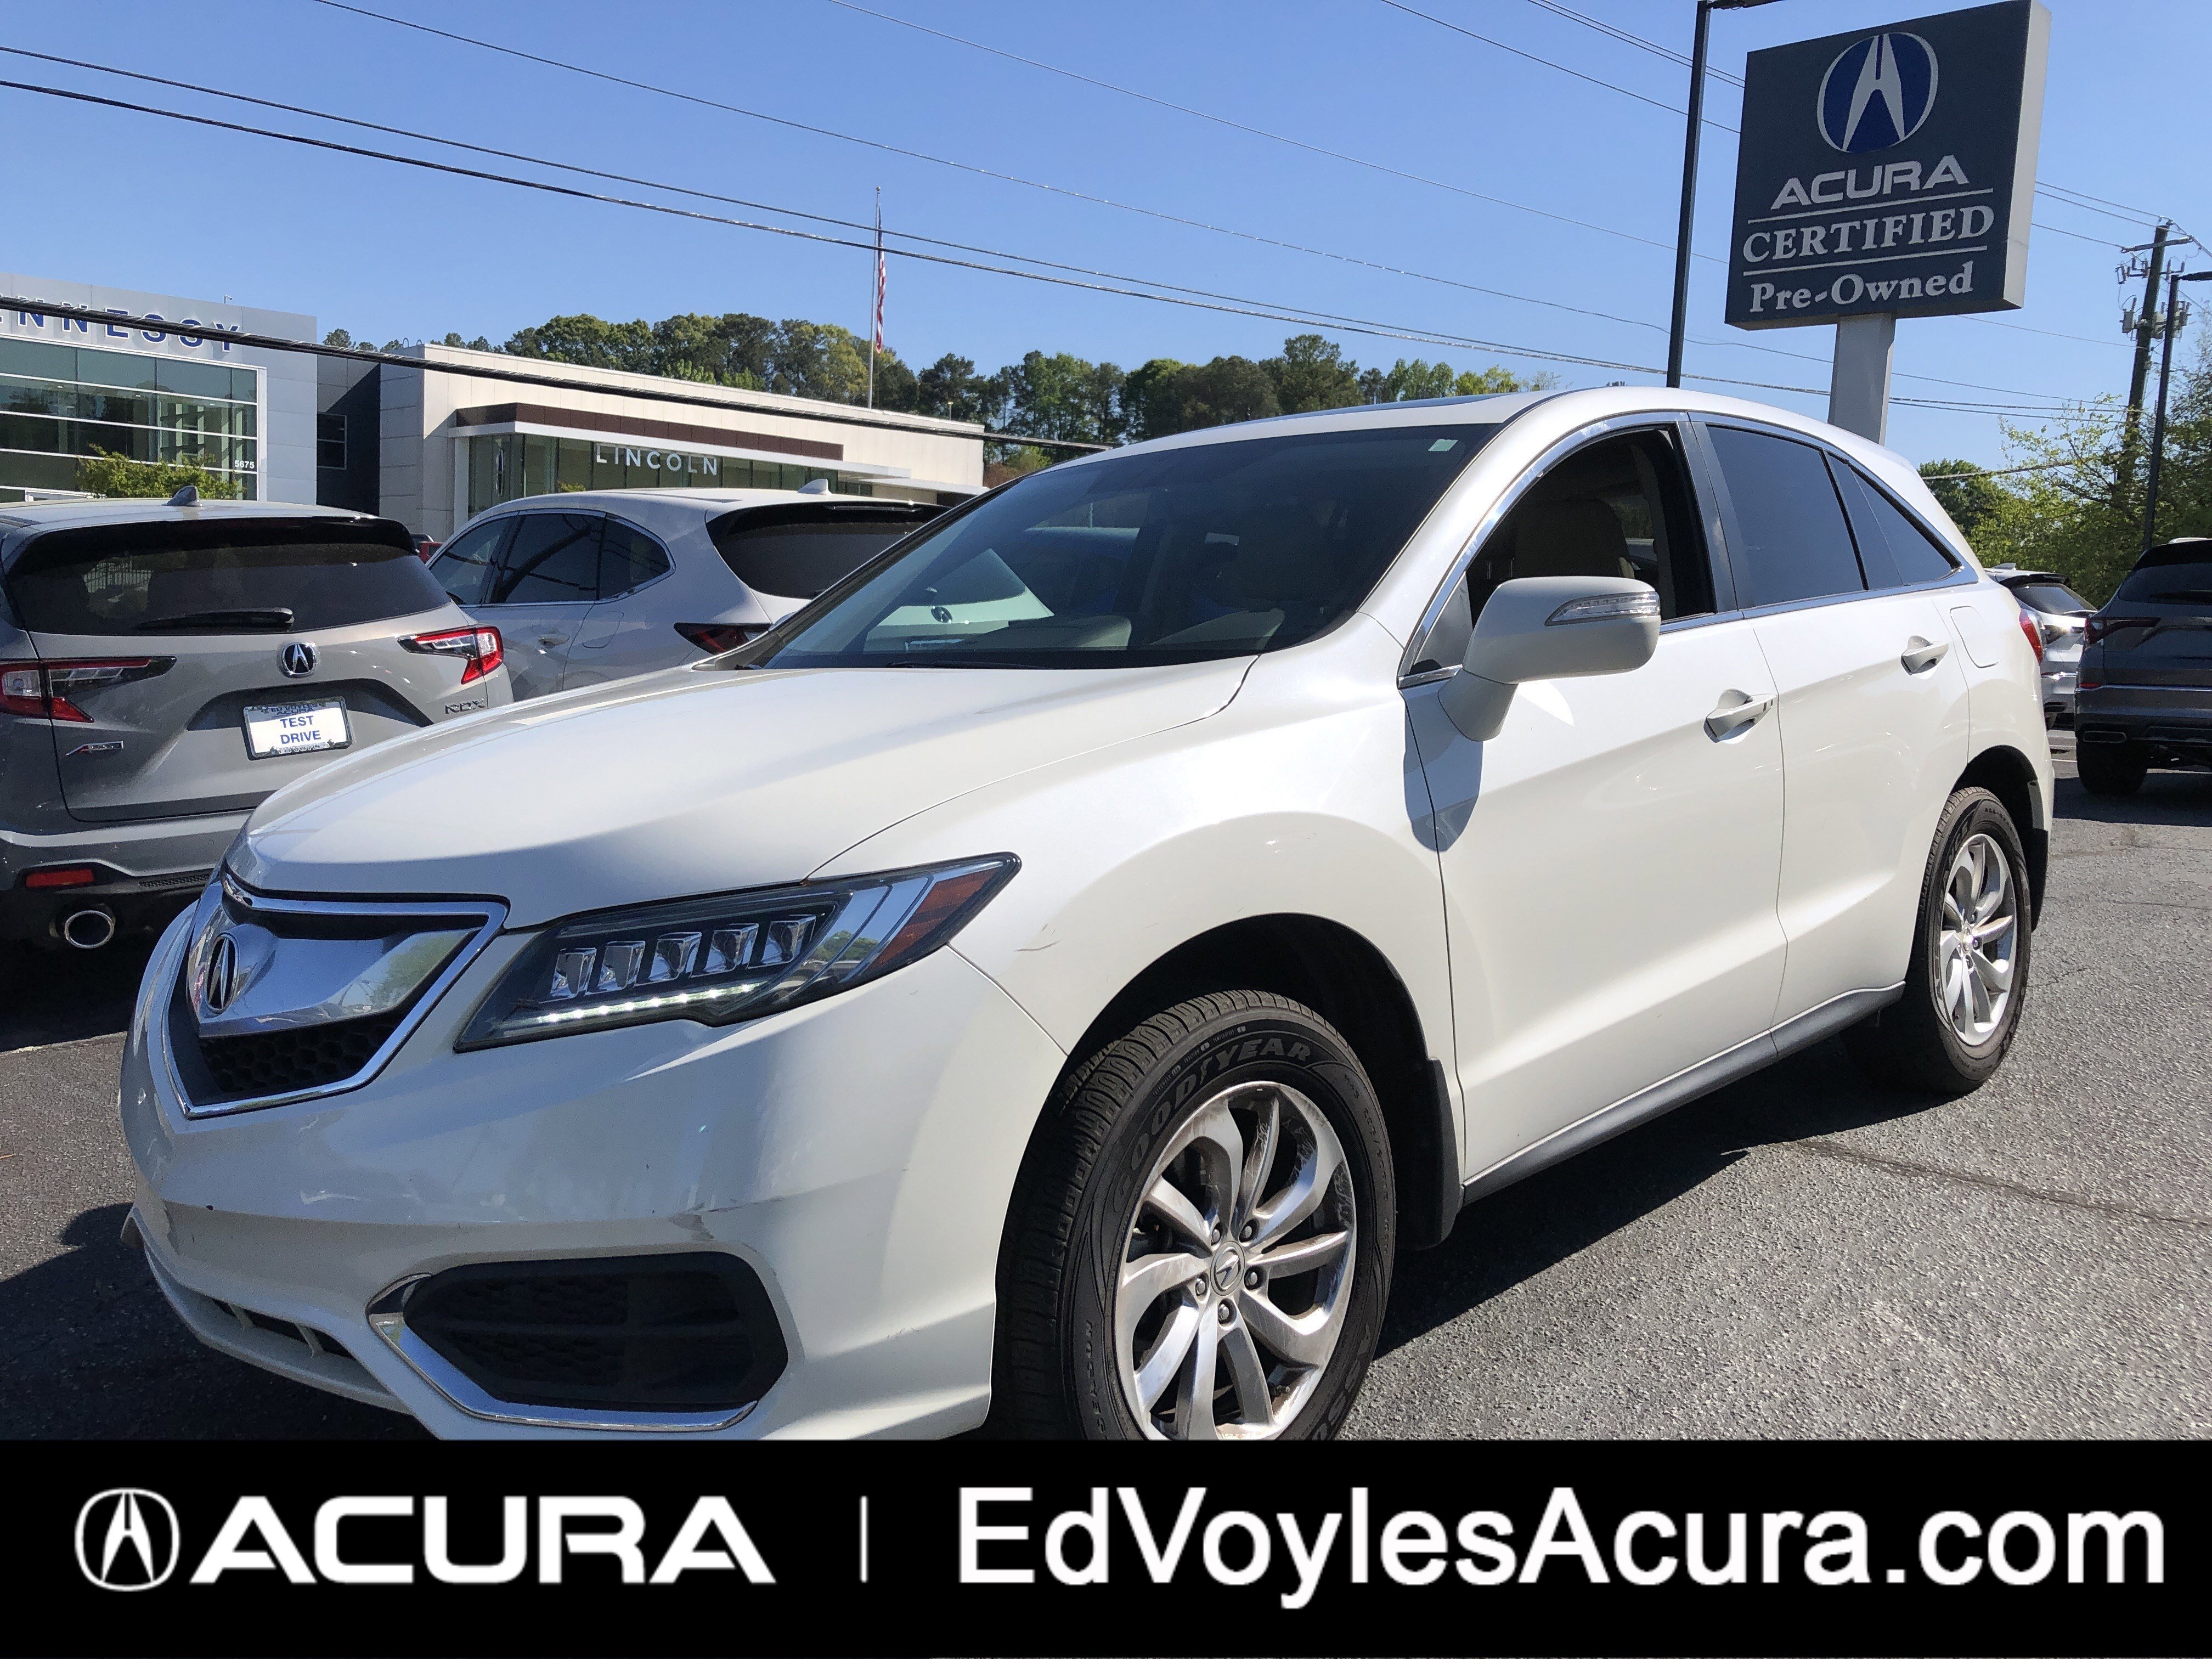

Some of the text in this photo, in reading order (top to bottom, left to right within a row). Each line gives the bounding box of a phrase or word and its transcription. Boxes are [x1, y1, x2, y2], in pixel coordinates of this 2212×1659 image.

[1771, 155, 1970, 210] ACURA
[1743, 205, 1994, 262] CERTIFIED
[1750, 260, 1974, 313] Pre-Owned
[0, 294, 240, 352] NNESSY
[234, 460, 255, 469] 5675
[596, 444, 717, 476] LINCOLN
[280, 715, 314, 729] TEST
[280, 730, 321, 744] DRIVE
[1113, 1037, 1312, 1213] GOODYEAR
